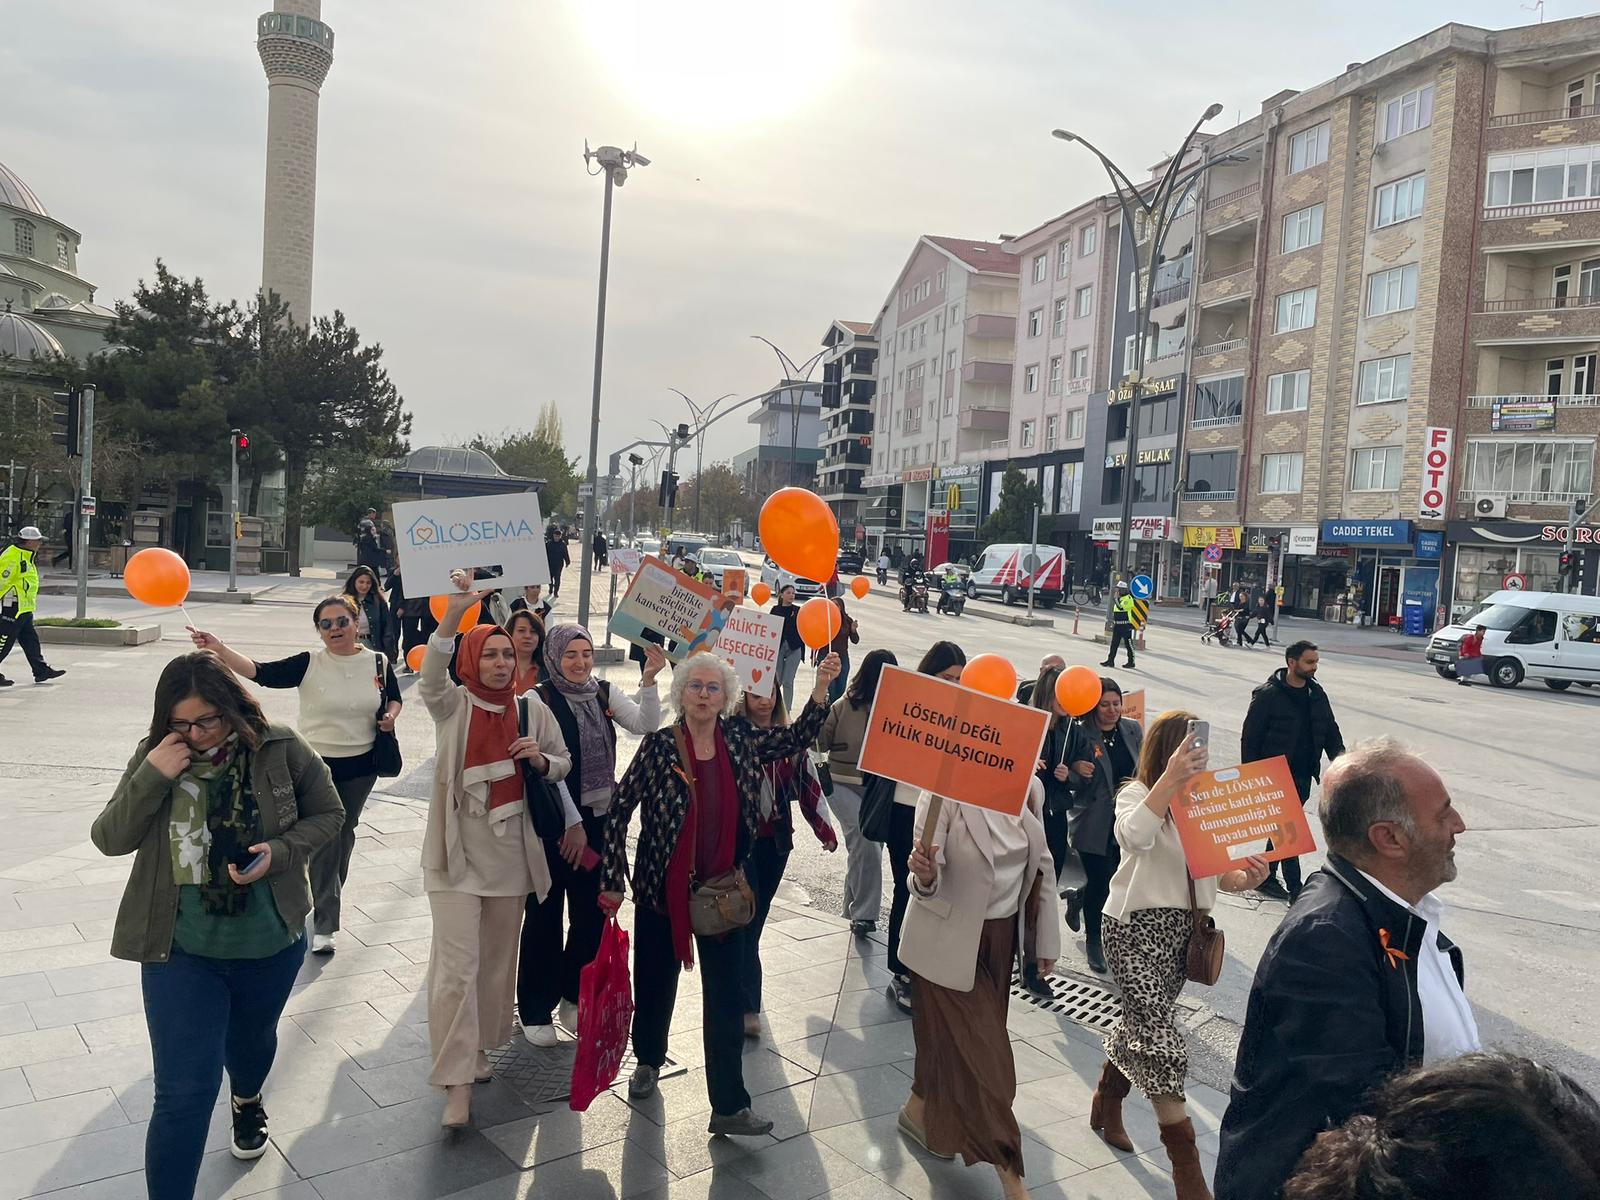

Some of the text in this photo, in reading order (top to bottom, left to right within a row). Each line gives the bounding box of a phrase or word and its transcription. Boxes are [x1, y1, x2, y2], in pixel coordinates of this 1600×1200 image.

[1138, 448, 1171, 464] EMLAK
[1423, 429, 1448, 509] FOTO
[439, 519, 534, 543] LÖSEMA
[1251, 528, 1266, 546] elit
[1332, 526, 1394, 537] CADDE TEKEL
[634, 592, 693, 629] kansere karşı
[658, 594, 699, 621] güçlüyüz
[671, 585, 704, 610] birlikte
[658, 617, 667, 627] el
[903, 702, 1002, 746] LÖSEMİ DEĞİL
[882, 717, 1014, 773] İYİLİK BULAŞICIDIR
[1189, 790, 1211, 803] Sen
[1211, 786, 1225, 798] de
[1226, 775, 1273, 795] LÖSEMA
[1187, 789, 1285, 819] ailesine katıl akran
[1199, 804, 1282, 832] danışmanlığı ile
[1212, 822, 1279, 845] hayata tutun
